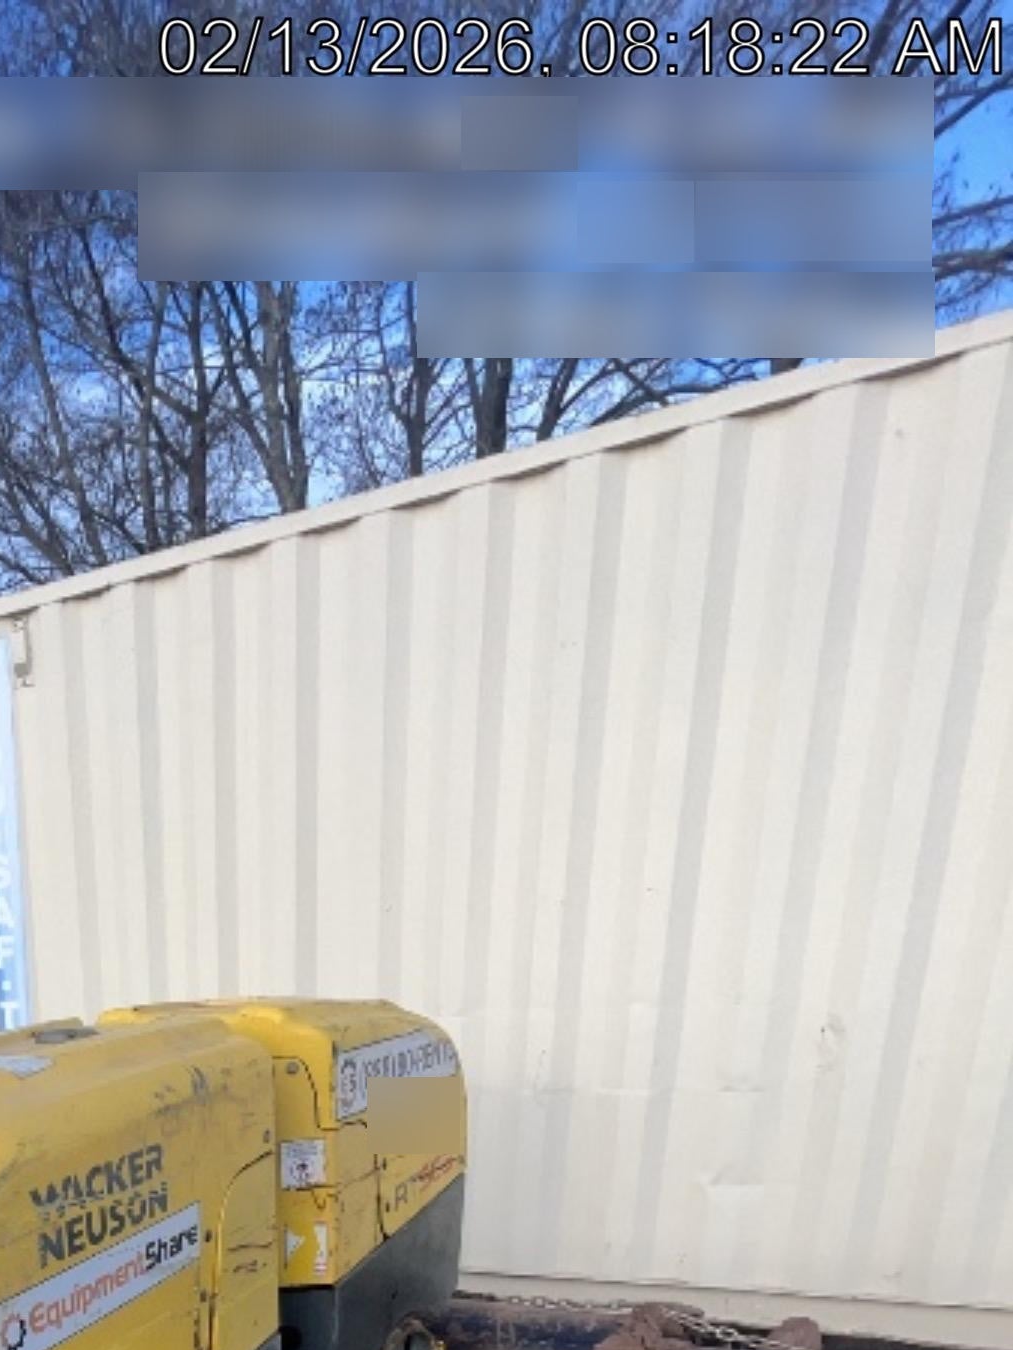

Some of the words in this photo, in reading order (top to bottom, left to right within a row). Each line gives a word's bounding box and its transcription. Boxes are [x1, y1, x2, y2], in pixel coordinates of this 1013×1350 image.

[29, 1143, 163, 1221] WACKER
[37, 1181, 169, 1269] NEUSON
[28, 1224, 197, 1335] EquipmentShare
